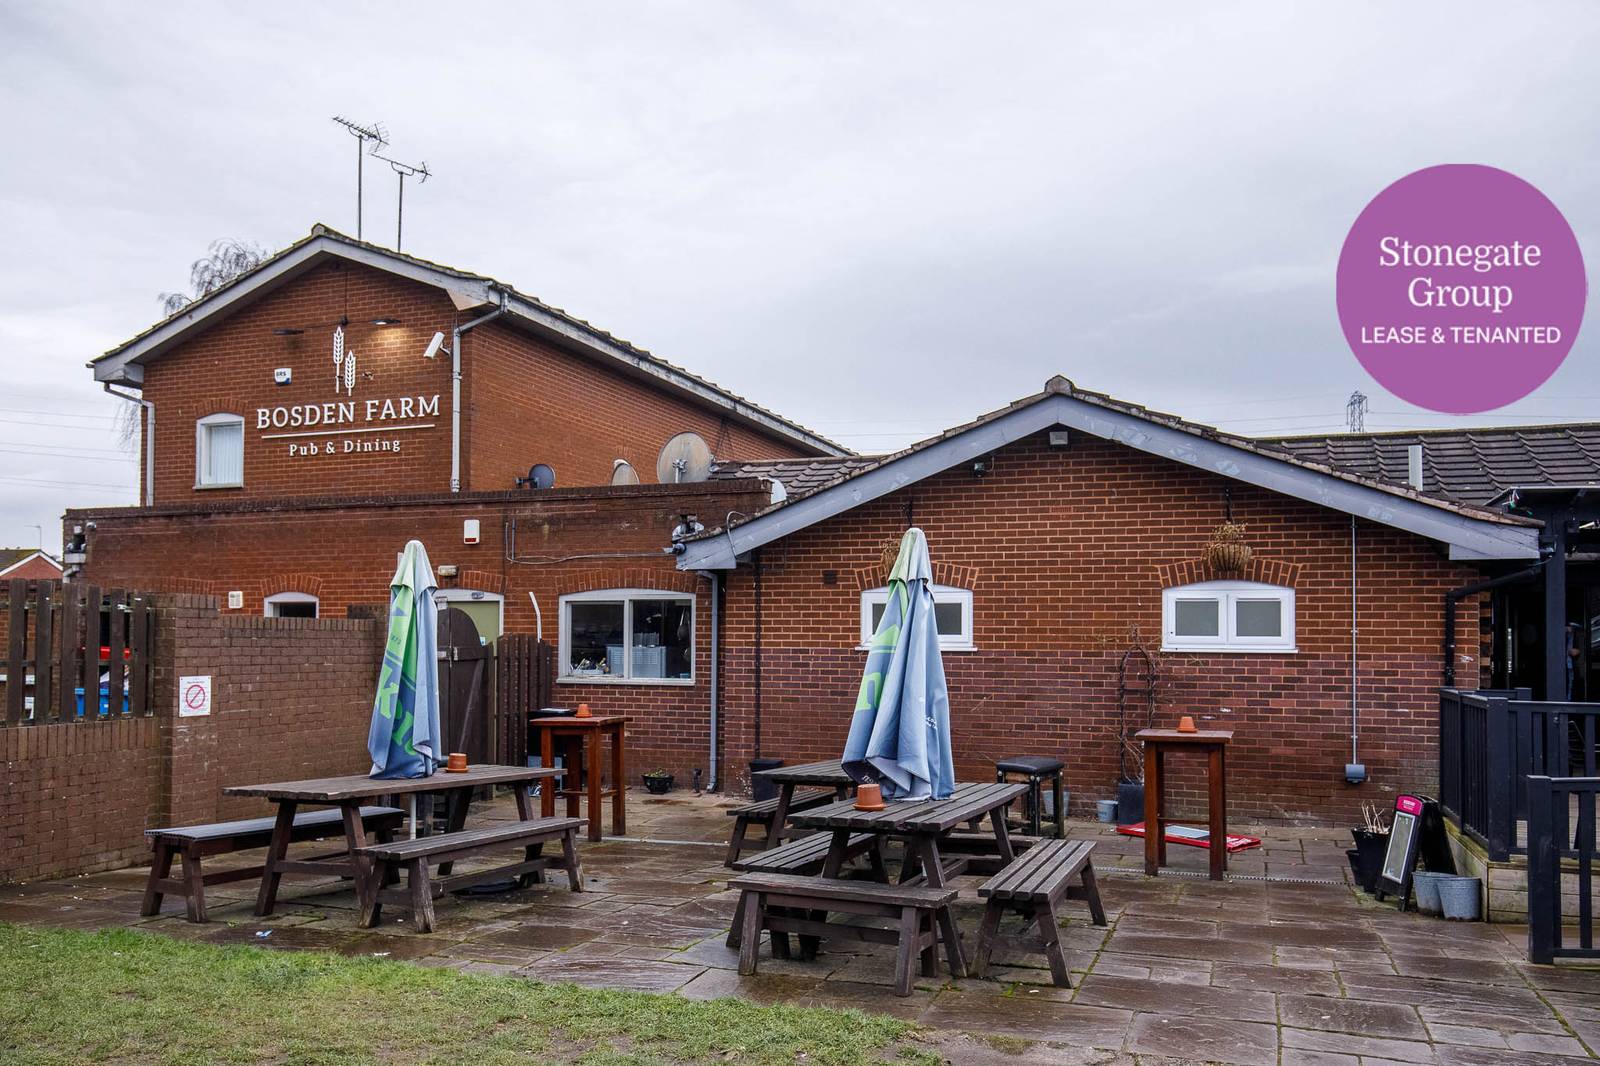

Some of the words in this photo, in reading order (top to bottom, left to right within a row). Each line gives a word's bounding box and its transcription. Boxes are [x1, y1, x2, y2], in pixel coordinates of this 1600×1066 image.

[257, 402, 355, 429] BOSDEN
[365, 395, 440, 421] FARM
[289, 443, 318, 456] Pub
[326, 442, 335, 454] &
[344, 438, 401, 453] Dining
